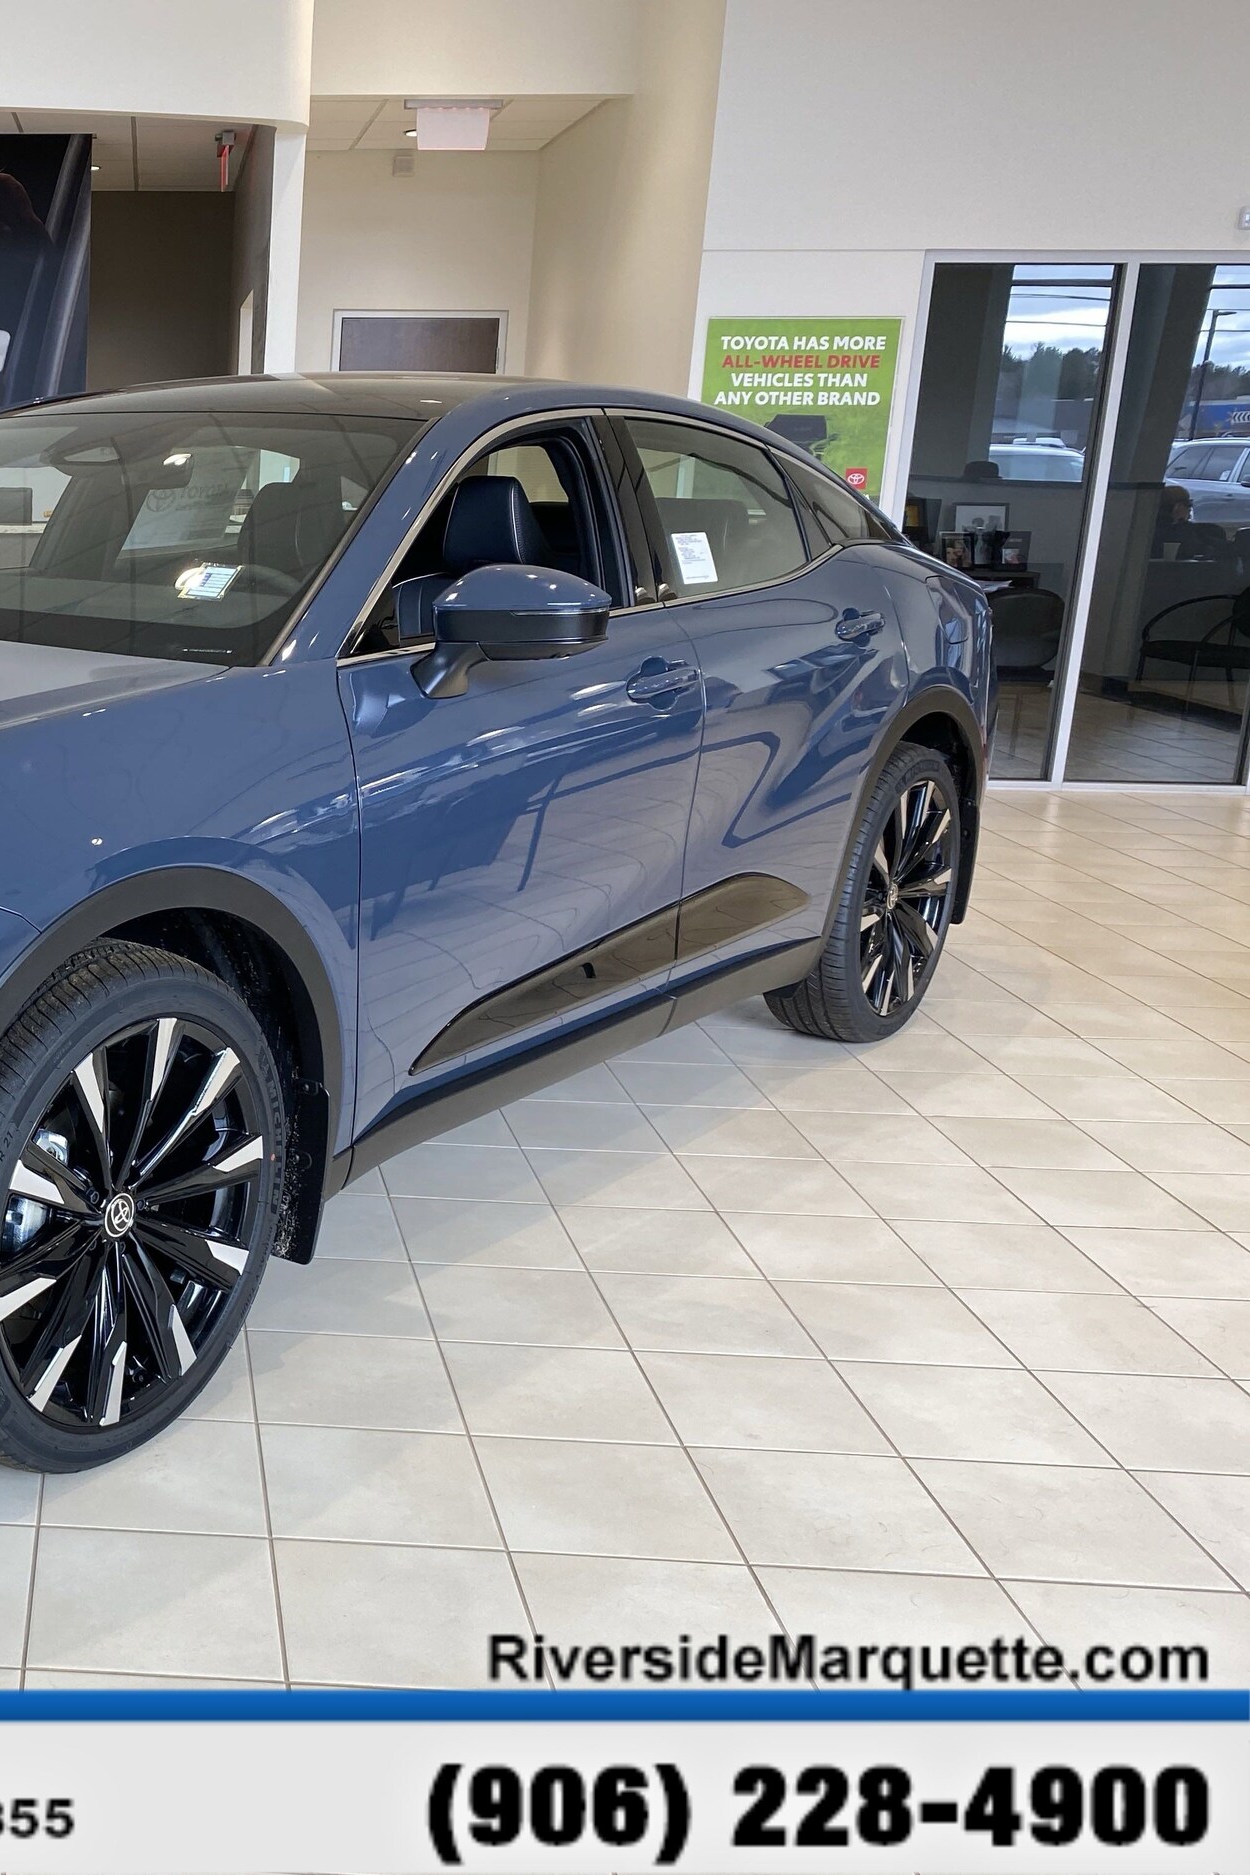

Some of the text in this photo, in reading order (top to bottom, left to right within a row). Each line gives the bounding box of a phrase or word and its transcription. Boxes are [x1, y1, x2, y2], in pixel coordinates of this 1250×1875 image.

[721, 336, 887, 351] TOYOTA HAS MORE
[722, 354, 881, 369] ALL-WHEEL DRIVE
[731, 372, 867, 388] VEHICLES THAN
[714, 391, 881, 406] ANY OTHER BRAND
